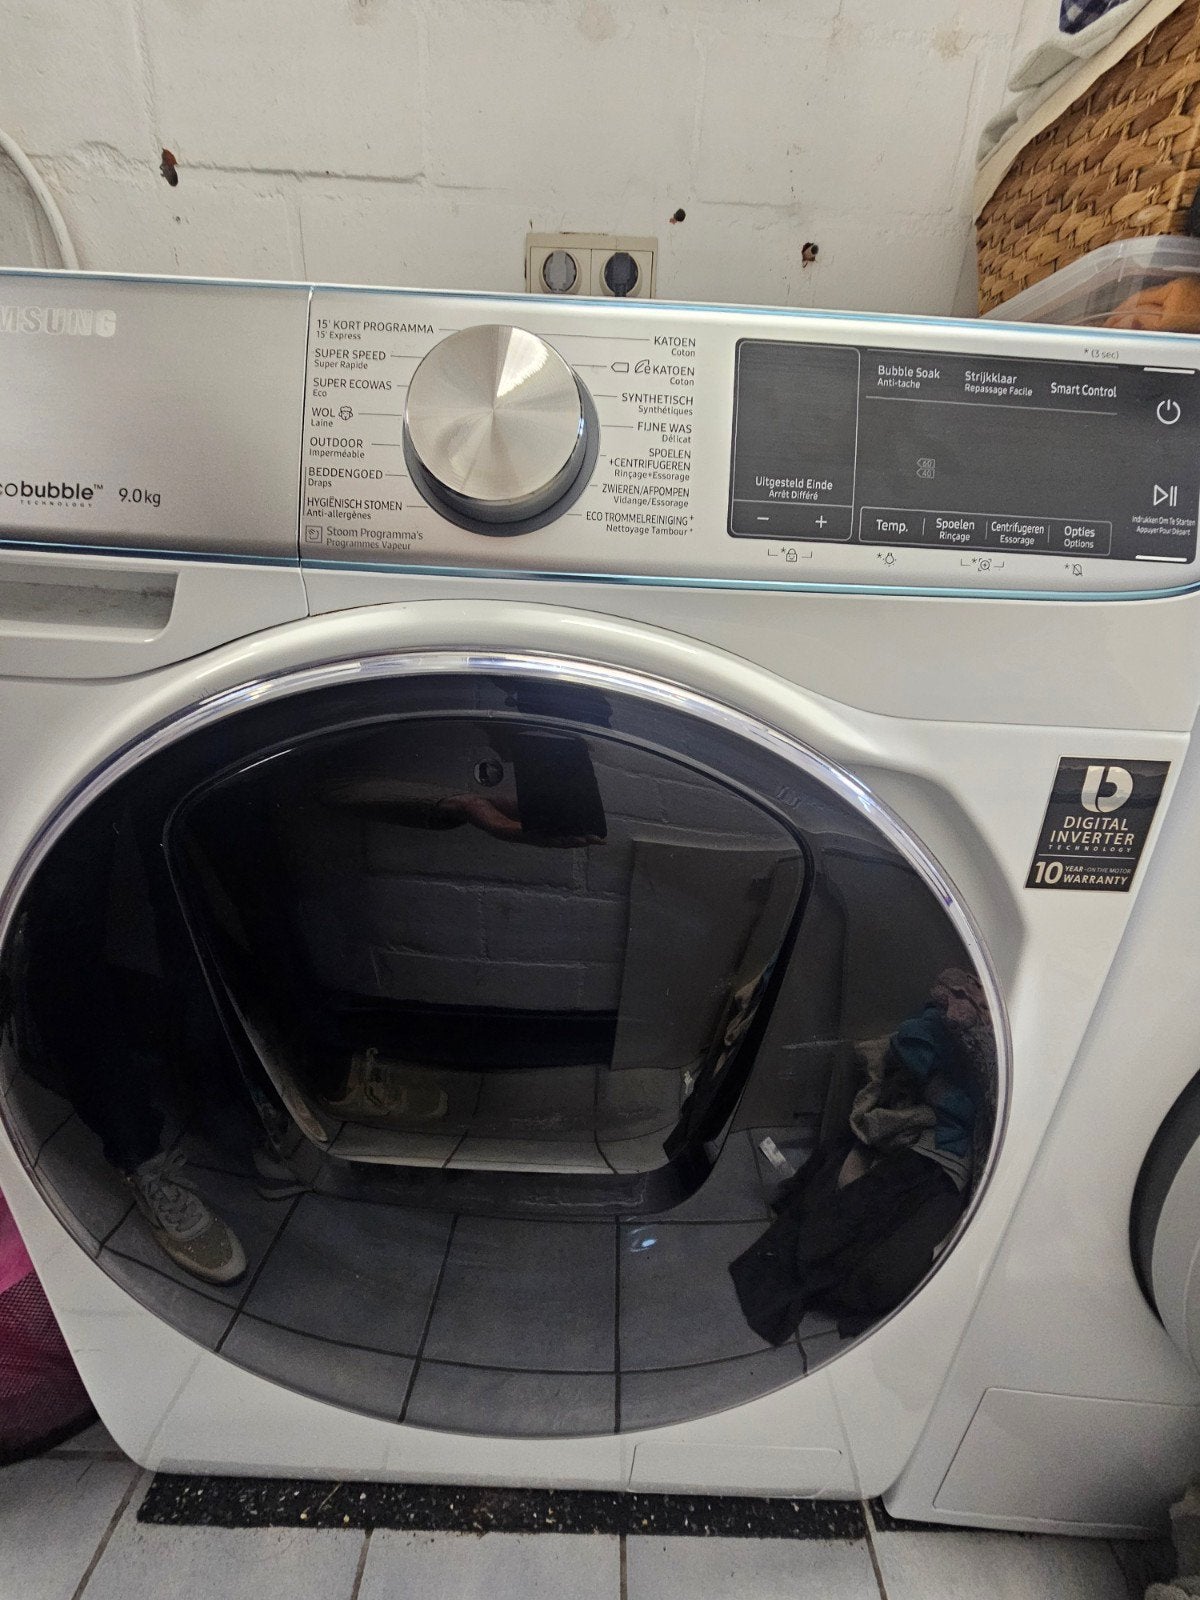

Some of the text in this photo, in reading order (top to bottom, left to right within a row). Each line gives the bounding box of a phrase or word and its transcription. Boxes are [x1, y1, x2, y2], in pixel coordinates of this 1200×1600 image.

[334, 321, 361, 330] KORT
[364, 322, 434, 334] PROGRAMMA
[330, 332, 361, 340] Express
[654, 336, 696, 347] KATOEN
[315, 348, 386, 360] SUPER SPEED
[671, 348, 696, 357] Coton
[315, 360, 368, 370] Super Rapide
[878, 365, 940, 379] Bubble Soak
[965, 370, 1017, 385] Strijkklaar
[314, 378, 392, 390] SUPER ECOWAS
[670, 377, 695, 386] Coton
[878, 378, 921, 389] Anti-tache
[313, 389, 327, 397] Eco
[964, 383, 1033, 397] Repassage Facile
[1051, 382, 1117, 398] Smart Control
[622, 393, 694, 406] SYNTHETISCH
[312, 407, 335, 417] WOL
[639, 405, 693, 416] Synthétiques
[311, 419, 334, 427] Laine
[637, 422, 692, 434] FIJNE WAS
[310, 437, 363, 448] OUTDOOR
[662, 434, 691, 443] Délicat
[310, 449, 365, 459] Imperméable
[649, 448, 691, 459] SPOELEN
[309, 467, 383, 479] BEDDENGOED
[308, 478, 332, 488] Draps
[755, 476, 833, 491] Uitgesteld Einde
[769, 490, 818, 500] Arrêt Différé
[364, 500, 403, 511] STOMEN
[307, 509, 372, 521] Anti-allergènes
[586, 511, 603, 521] ECO
[606, 524, 649, 536] Nettoyage
[876, 519, 909, 534] Temp.
[936, 518, 975, 530] Spoelen
[991, 522, 1045, 536] Centrifugeren
[327, 526, 423, 540] Stoom Programma's
[940, 531, 971, 542] Rinçage
[1064, 526, 1096, 538] Opties
[326, 538, 411, 550] Programmes Vapeur
[1000, 535, 1035, 547] Essorage
[1064, 539, 1094, 549] Options
[1064, 816, 1129, 831] DIGITAL
[1050, 830, 1135, 846] INVERTER
[1049, 844, 1132, 853] TECHNOLOGY
[1035, 860, 1064, 884] 10
[1064, 874, 1128, 885] WARRANTY
